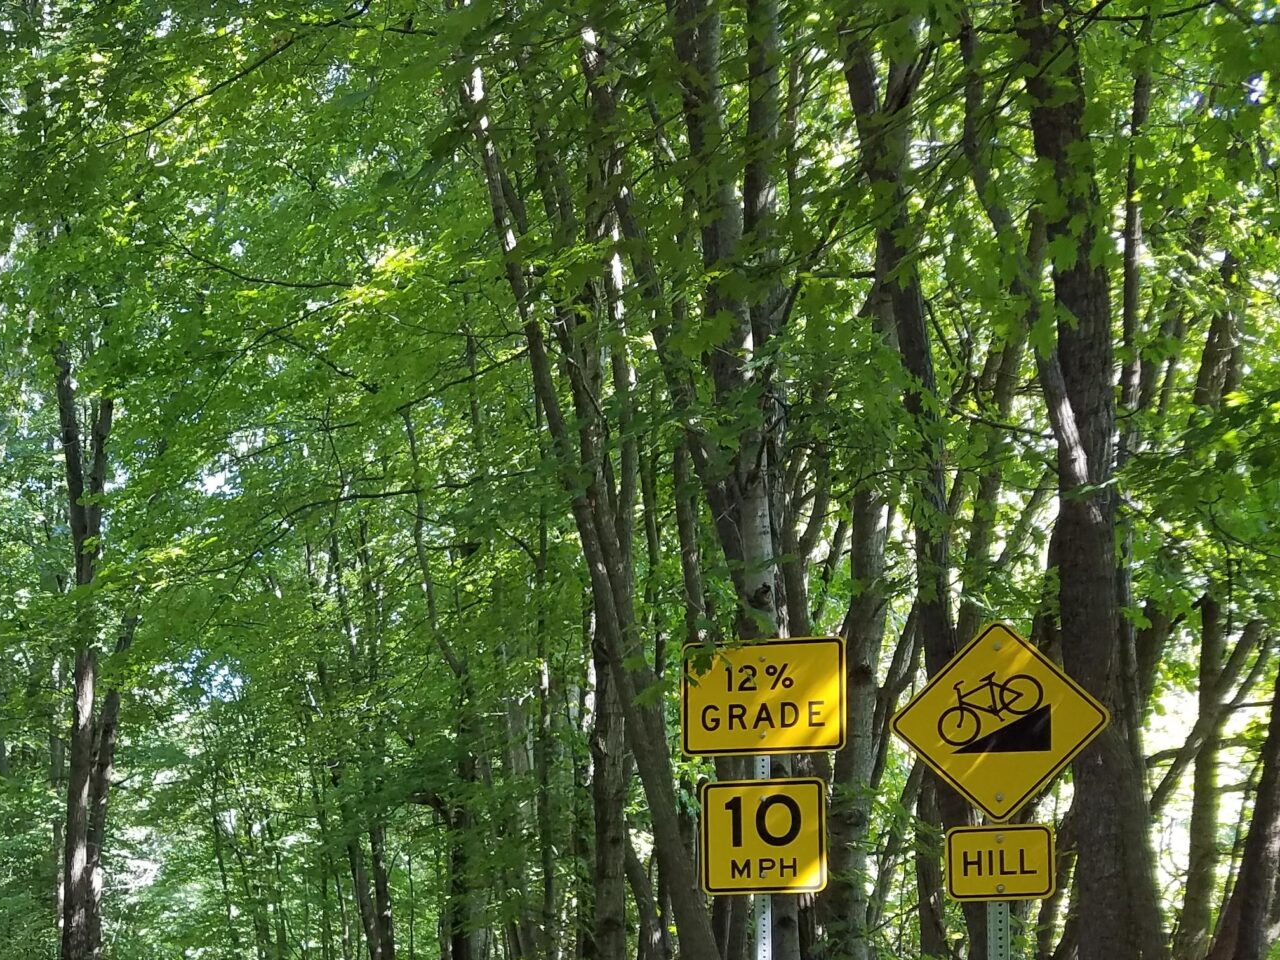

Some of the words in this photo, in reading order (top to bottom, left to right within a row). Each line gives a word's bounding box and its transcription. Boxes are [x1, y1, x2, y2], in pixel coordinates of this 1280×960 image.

[724, 663, 795, 692] 12%
[701, 701, 825, 732] GRADE
[724, 794, 802, 848] 10
[730, 857, 797, 879] MPH
[962, 848, 1038, 877] HILL
